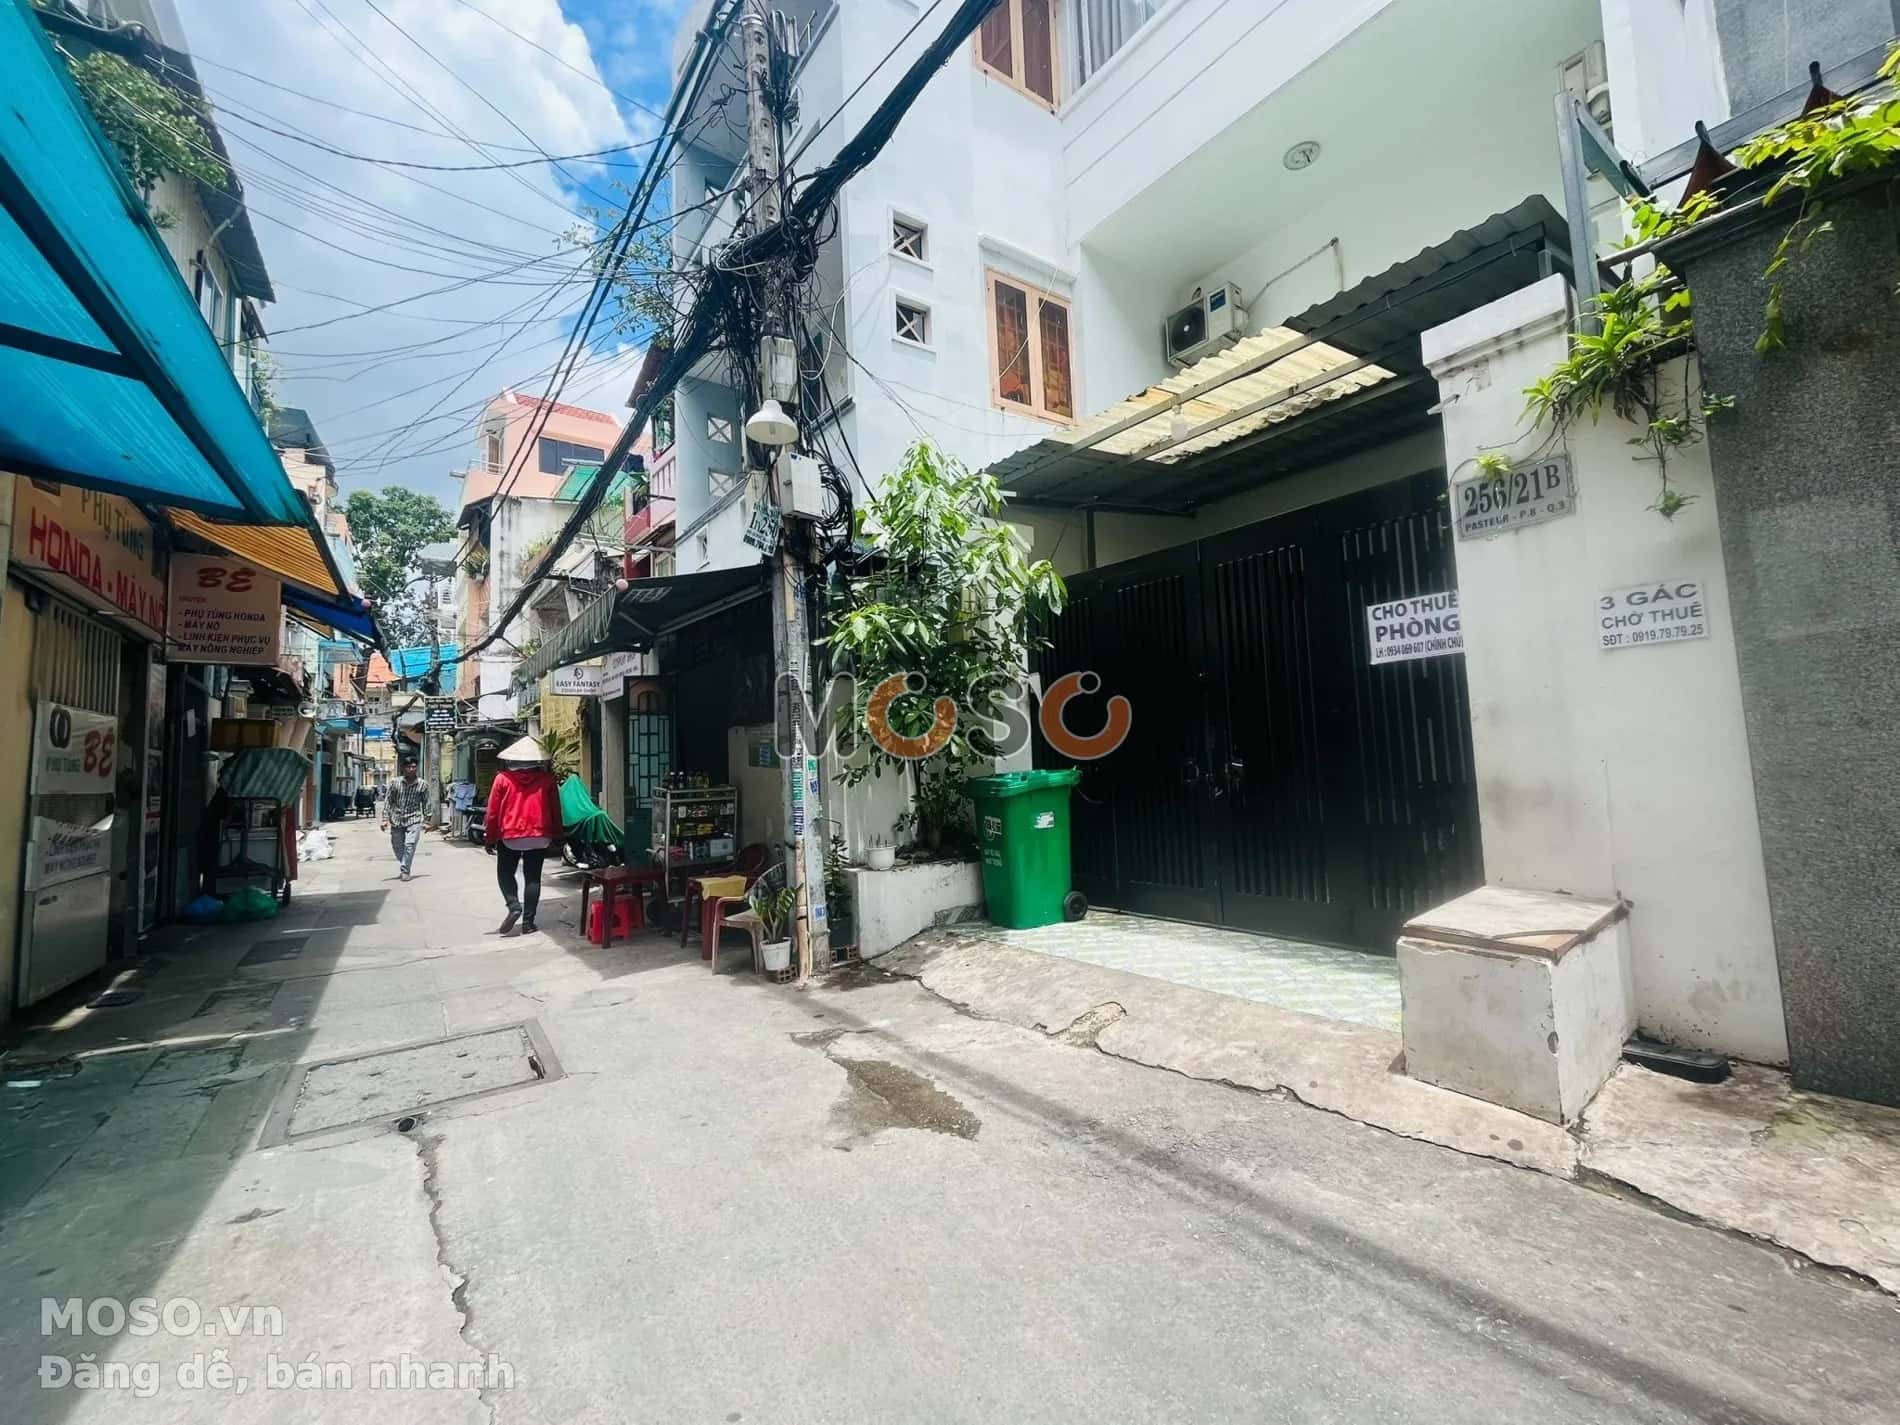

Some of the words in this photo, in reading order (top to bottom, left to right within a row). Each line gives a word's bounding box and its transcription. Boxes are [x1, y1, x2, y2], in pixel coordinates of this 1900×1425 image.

[1464, 463, 1562, 518] 256/21B
[1464, 514, 1509, 532] PASTEUR
[30, 505, 103, 596] HONDA
[1372, 602, 1408, 621] CHO
[1600, 596, 1616, 611] 3
[1376, 613, 1461, 642] PHÒNG
[556, 680, 572, 688] EASY
[572, 680, 601, 688] FANTASY
